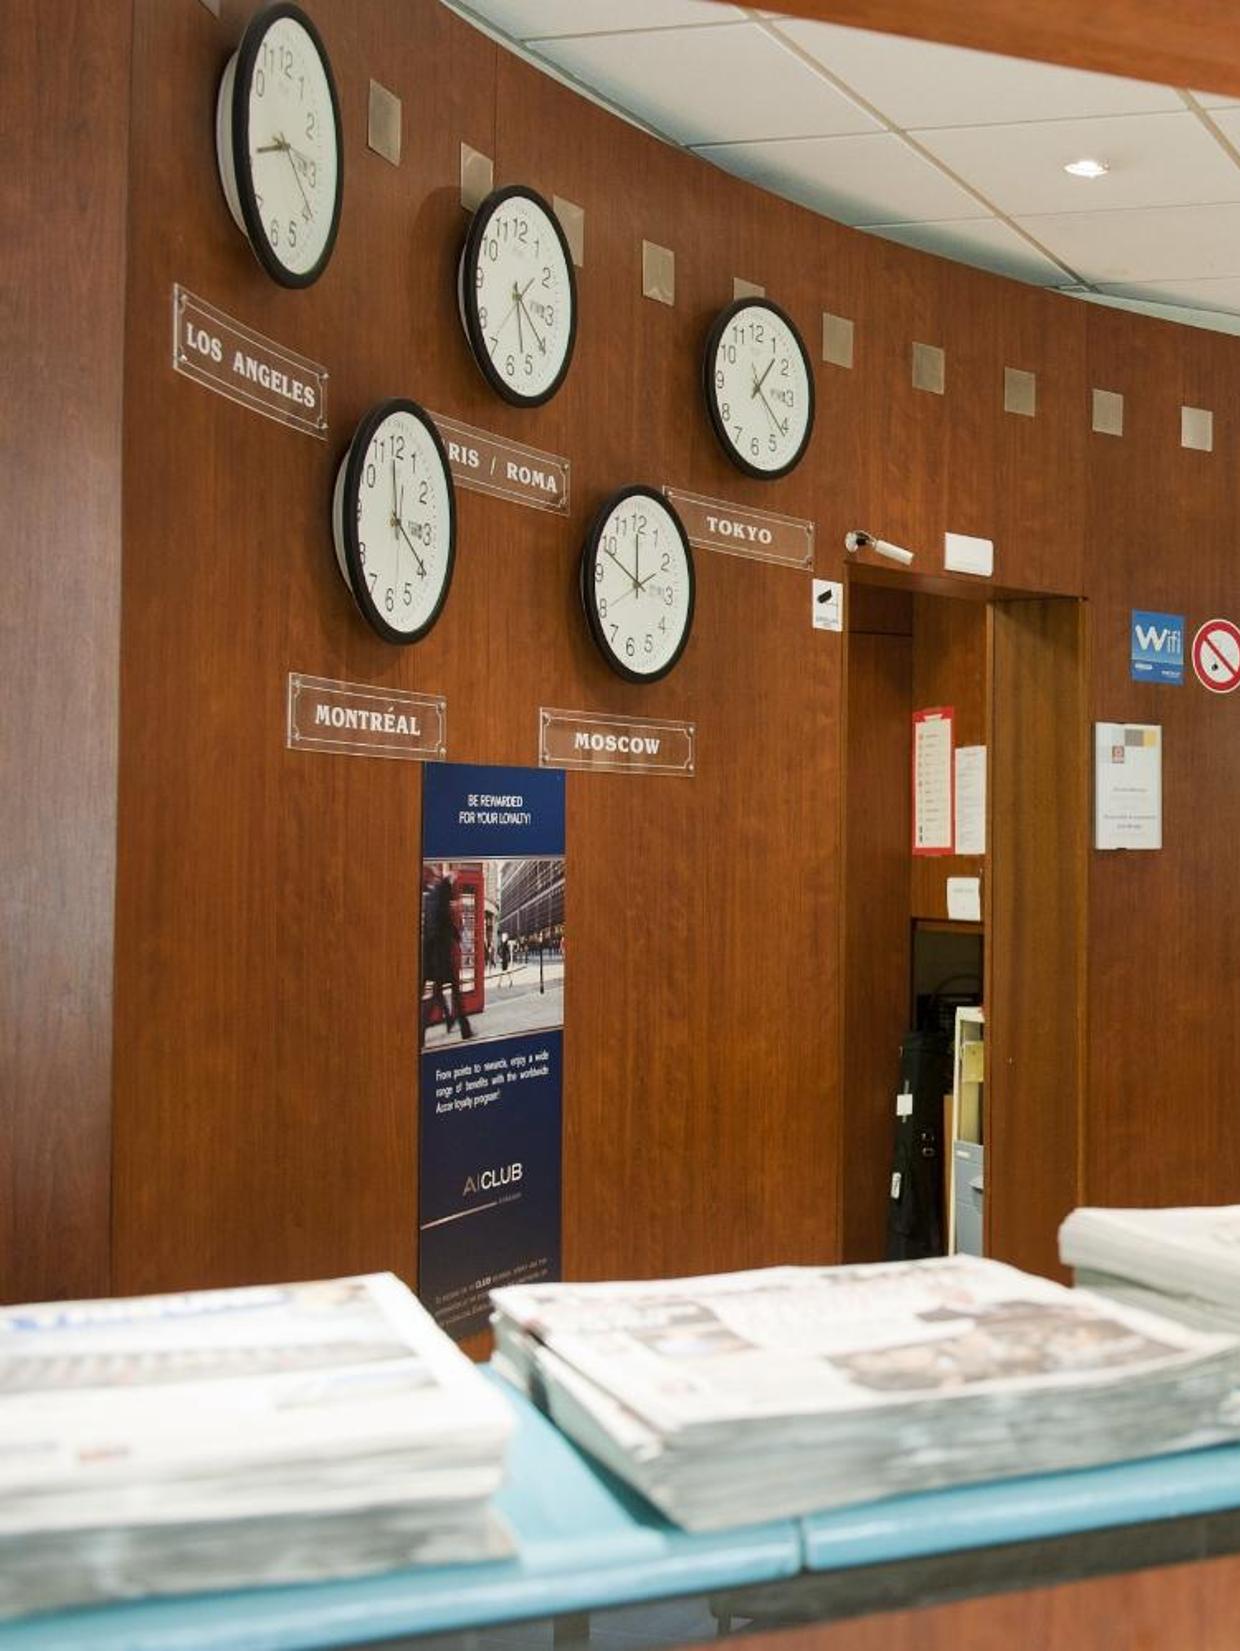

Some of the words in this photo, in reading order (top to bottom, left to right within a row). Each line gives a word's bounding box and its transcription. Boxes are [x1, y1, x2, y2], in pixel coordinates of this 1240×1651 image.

[279, 45, 293, 80] 12
[256, 69, 265, 98] 0
[305, 111, 315, 141] 2
[308, 160, 317, 188] 3
[270, 219, 279, 247] 6
[287, 219, 297, 248] 5
[495, 216, 509, 242] 11
[512, 217, 528, 244] 12
[483, 233, 498, 262] 10
[541, 266, 551, 289] 2
[544, 304, 554, 327] 3
[732, 325, 745, 345] 11
[748, 322, 764, 343] 12
[186, 322, 223, 362] LOS
[232, 351, 316, 408] ANGELES
[524, 354, 534, 376] 5
[720, 343, 737, 364] 10
[506, 354, 515, 377] 6
[780, 358, 790, 377] 2
[716, 369, 725, 389] 9
[721, 402, 731, 422] 8
[733, 425, 743, 444] 7
[768, 433, 777, 452] 5
[373, 437, 385, 464] 11
[390, 434, 405, 461] 12
[751, 437, 760, 456] 6
[441, 438, 480, 468] RIS
[506, 461, 559, 494] ROMA
[419, 480, 429, 505] 2
[422, 522, 432, 546] 3
[614, 514, 627, 537] 11
[631, 512, 648, 535] 12
[706, 515, 772, 545] TOKYO
[602, 533, 617, 556] 10
[595, 562, 604, 582] 9
[660, 552, 671, 573] 2
[369, 572, 378, 595] 7
[402, 581, 413, 607] 5
[385, 587, 394, 612] 6
[664, 585, 674, 606] 3
[599, 597, 608, 619] 8
[609, 623, 619, 643] 7
[657, 615, 667, 635] 4
[625, 636, 635, 657] 6
[643, 633, 654, 654] 5
[1134, 624, 1181, 654] Wifi
[315, 704, 421, 736] MONTRÉAL
[574, 731, 661, 755] MOSCOW
[467, 794, 479, 807] BE
[480, 794, 523, 807] REWARDED
[459, 811, 476, 824] FOR
[477, 811, 498, 824] YOUR
[436, 1069, 452, 1081] From
[454, 1065, 472, 1081] points
[474, 1063, 482, 1074] to
[466, 1077, 489, 1091] benefits
[491, 1074, 505, 1085] with
[507, 1071, 517, 1082] the
